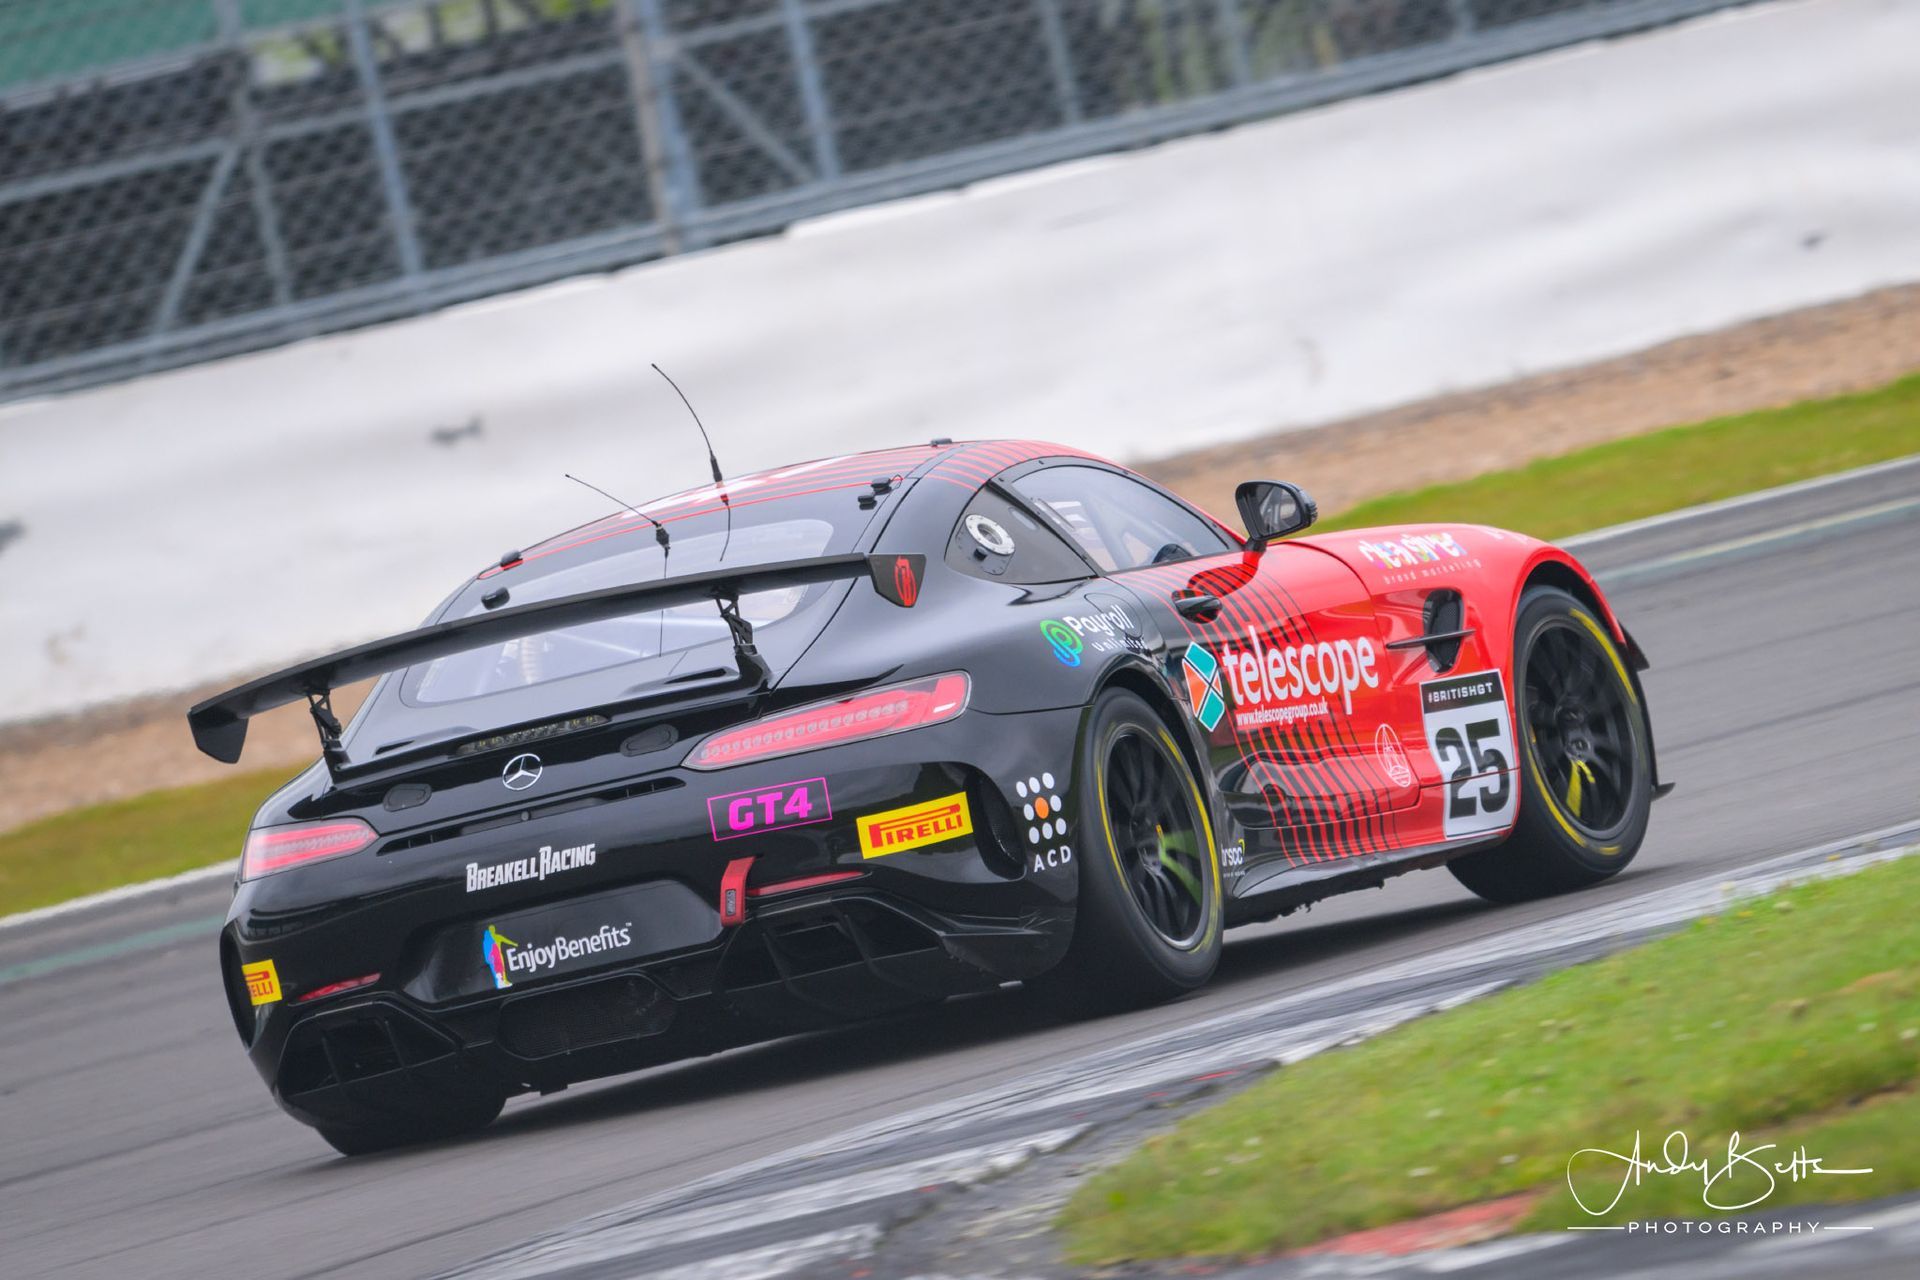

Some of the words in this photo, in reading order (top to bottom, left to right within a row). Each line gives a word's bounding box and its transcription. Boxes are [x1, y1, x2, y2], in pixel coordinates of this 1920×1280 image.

[1062, 604, 1134, 636] Payroll
[1222, 625, 1379, 715] telescope
[1235, 695, 1329, 726] www.telescopegroup.co.uk
[1428, 682, 1493, 703] #BRITISHGT
[1435, 718, 1510, 819] 25
[728, 787, 813, 831] GT4
[868, 803, 963, 849] PIRELLI
[466, 857, 539, 893] BREAKELL
[539, 843, 596, 881] RACING
[1034, 845, 1071, 873] ACD
